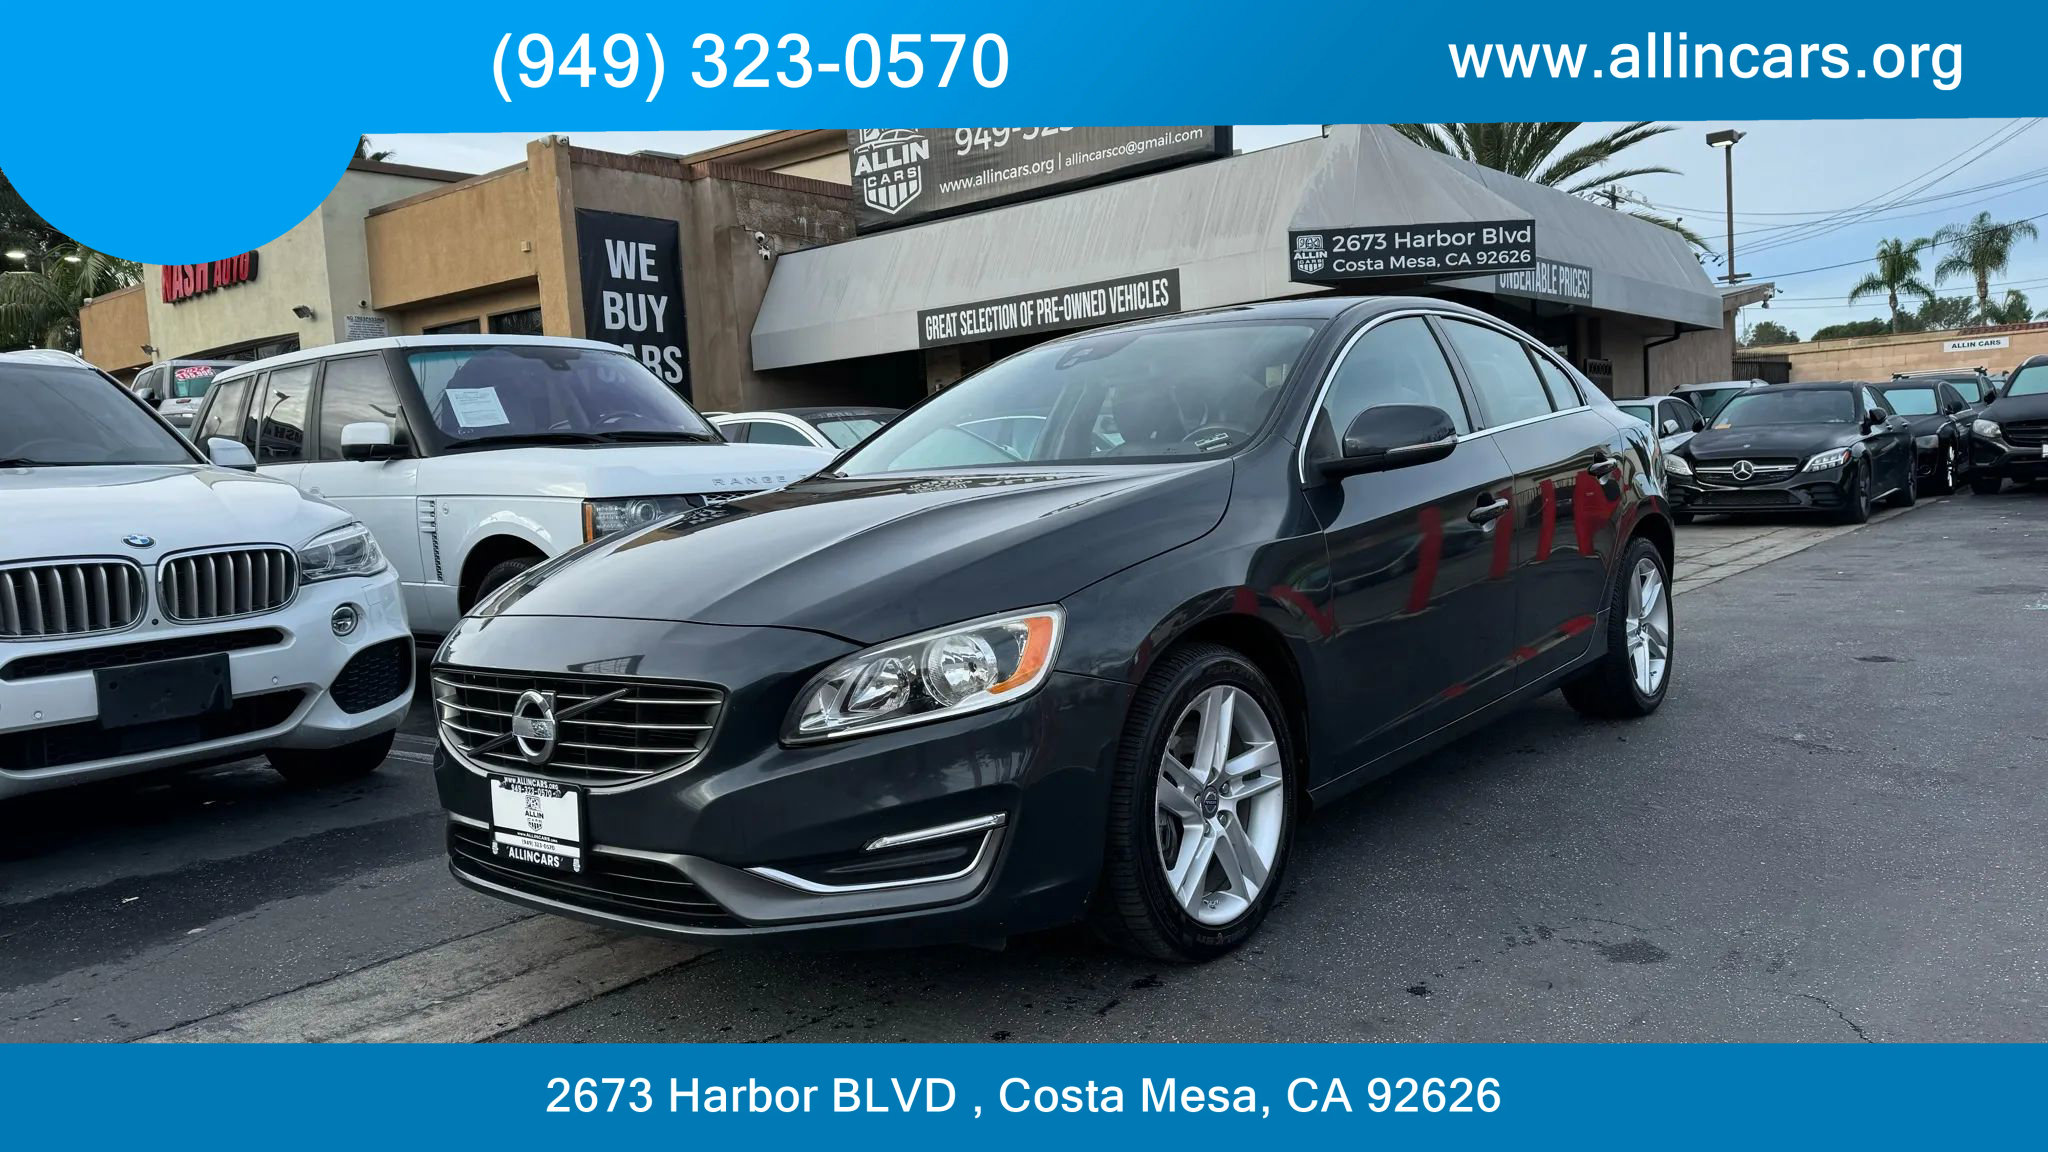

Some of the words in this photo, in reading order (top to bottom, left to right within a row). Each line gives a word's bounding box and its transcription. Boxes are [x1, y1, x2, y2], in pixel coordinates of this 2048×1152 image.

[854, 138, 930, 176] ALLIN
[939, 158, 1055, 194] www.allincars.org
[1065, 127, 1203, 168] allincarsco@gmail.com
[867, 166, 917, 188] CARS
[1293, 250, 1328, 260] ALLIN
[1332, 233, 1387, 253] 2673
[1394, 229, 1476, 249] Harbor
[1482, 225, 1531, 245] Blvd
[213, 252, 251, 288] AUTO
[604, 238, 659, 283] WE
[1332, 258, 1384, 272] Costa
[1390, 255, 1441, 270] Mesa,
[1445, 252, 1472, 266] CA
[1476, 250, 1531, 265] 92626
[1559, 265, 1590, 300] PRICES!
[602, 290, 669, 333] BUY
[925, 311, 958, 341] GREAT
[960, 302, 1018, 336] SELECTION
[1020, 301, 1034, 328] OF
[1036, 288, 1107, 326] PRE-OWNED
[1108, 278, 1169, 314] VEHICLES
[712, 475, 788, 487] RANGE
[525, 810, 544, 819] ALLIN
